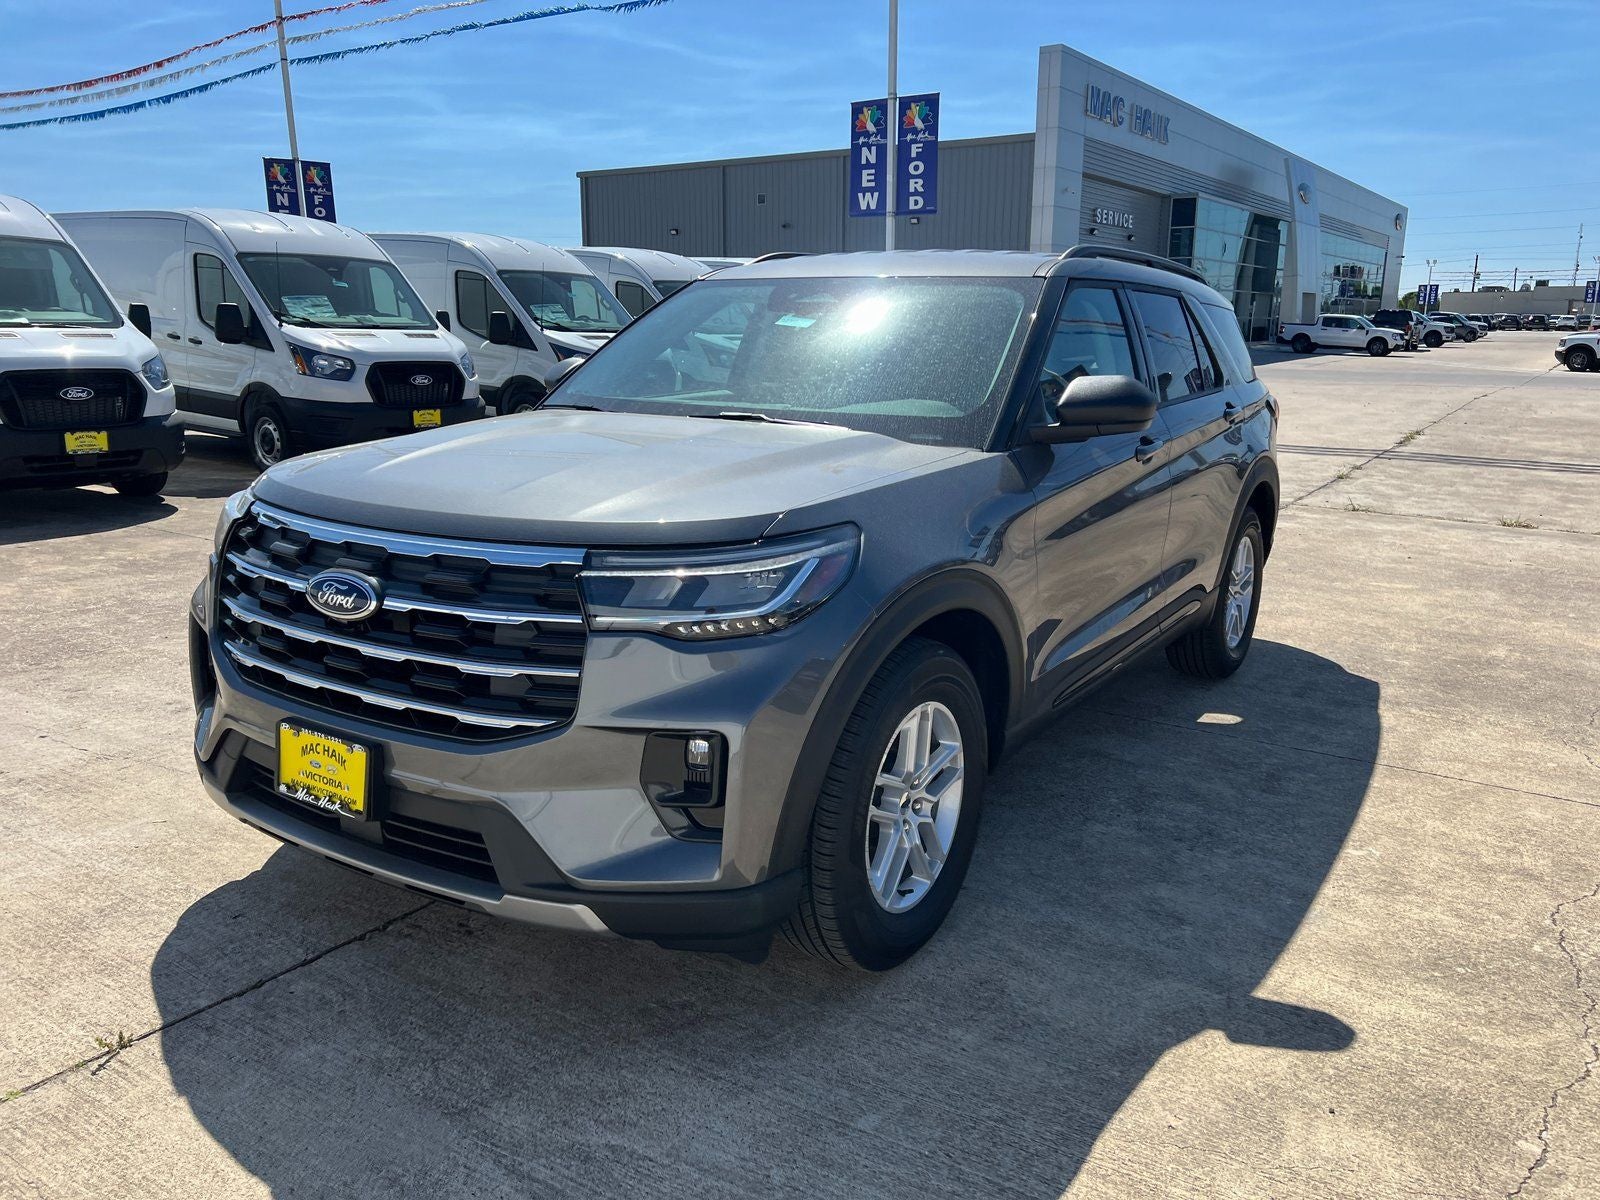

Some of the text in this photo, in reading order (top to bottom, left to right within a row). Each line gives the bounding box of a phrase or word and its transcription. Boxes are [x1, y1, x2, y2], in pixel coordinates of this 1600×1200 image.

[1084, 83, 1171, 145] MAC HAIK
[858, 145, 879, 210] NEW
[909, 143, 925, 210] FORD
[1096, 208, 1133, 229] SERVICE
[66, 388, 88, 398] Ford
[317, 581, 358, 609] Ford
[301, 742, 347, 771] MAC HAIK
[304, 769, 343, 790] VICTORIA
[295, 787, 317, 804] Mac
